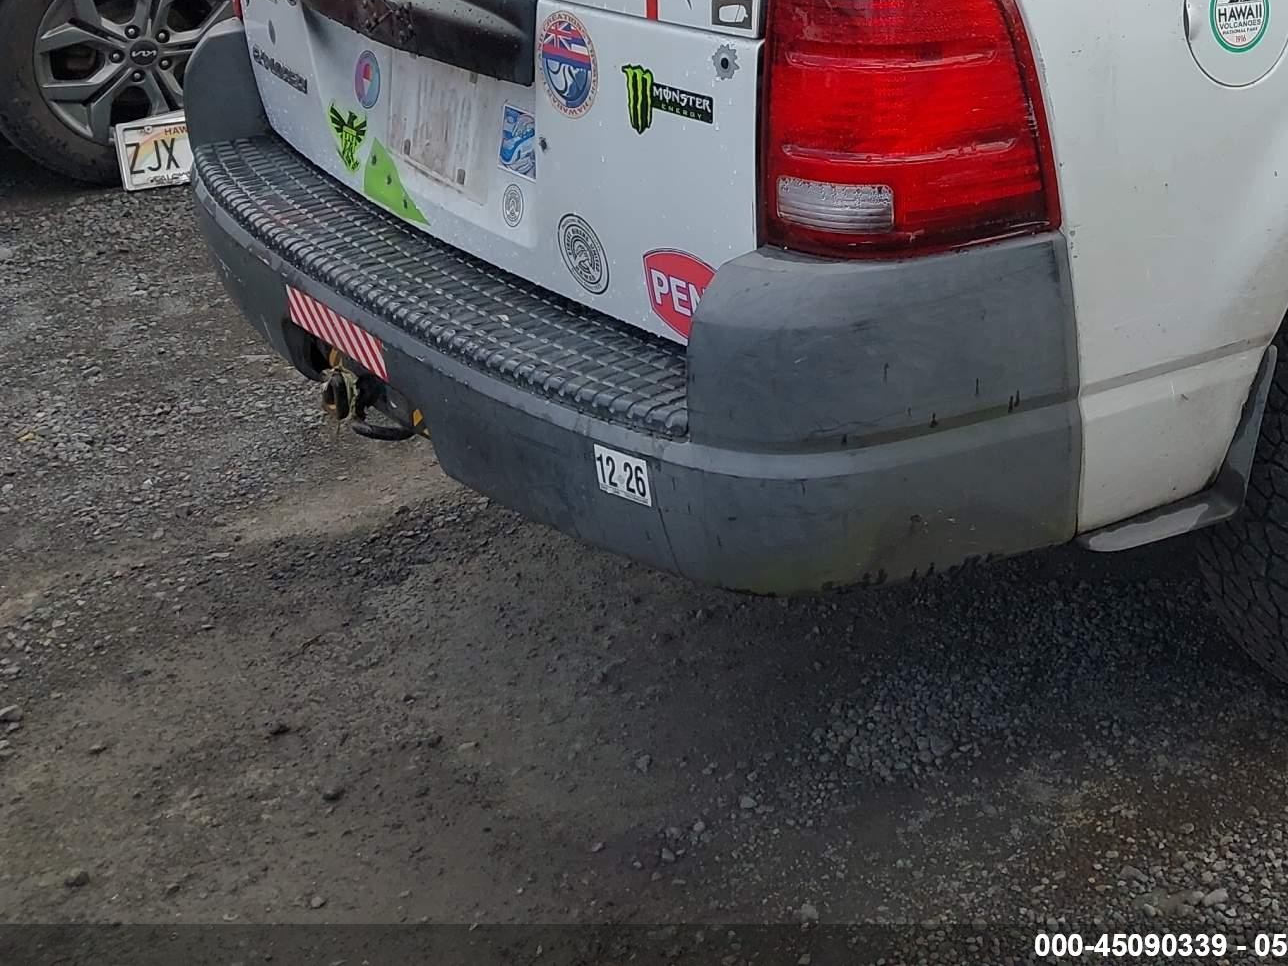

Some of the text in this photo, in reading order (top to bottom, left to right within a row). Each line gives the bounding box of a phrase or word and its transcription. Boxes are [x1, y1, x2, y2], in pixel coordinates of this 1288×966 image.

[1218, 3, 1263, 23] HAWAII
[1219, 19, 1262, 31] VOLCANOES
[652, 85, 711, 113] MONSTER
[661, 103, 702, 120] ENERGY
[125, 137, 180, 174] ZJX
[596, 454, 617, 487] 12
[623, 462, 646, 497] 26
